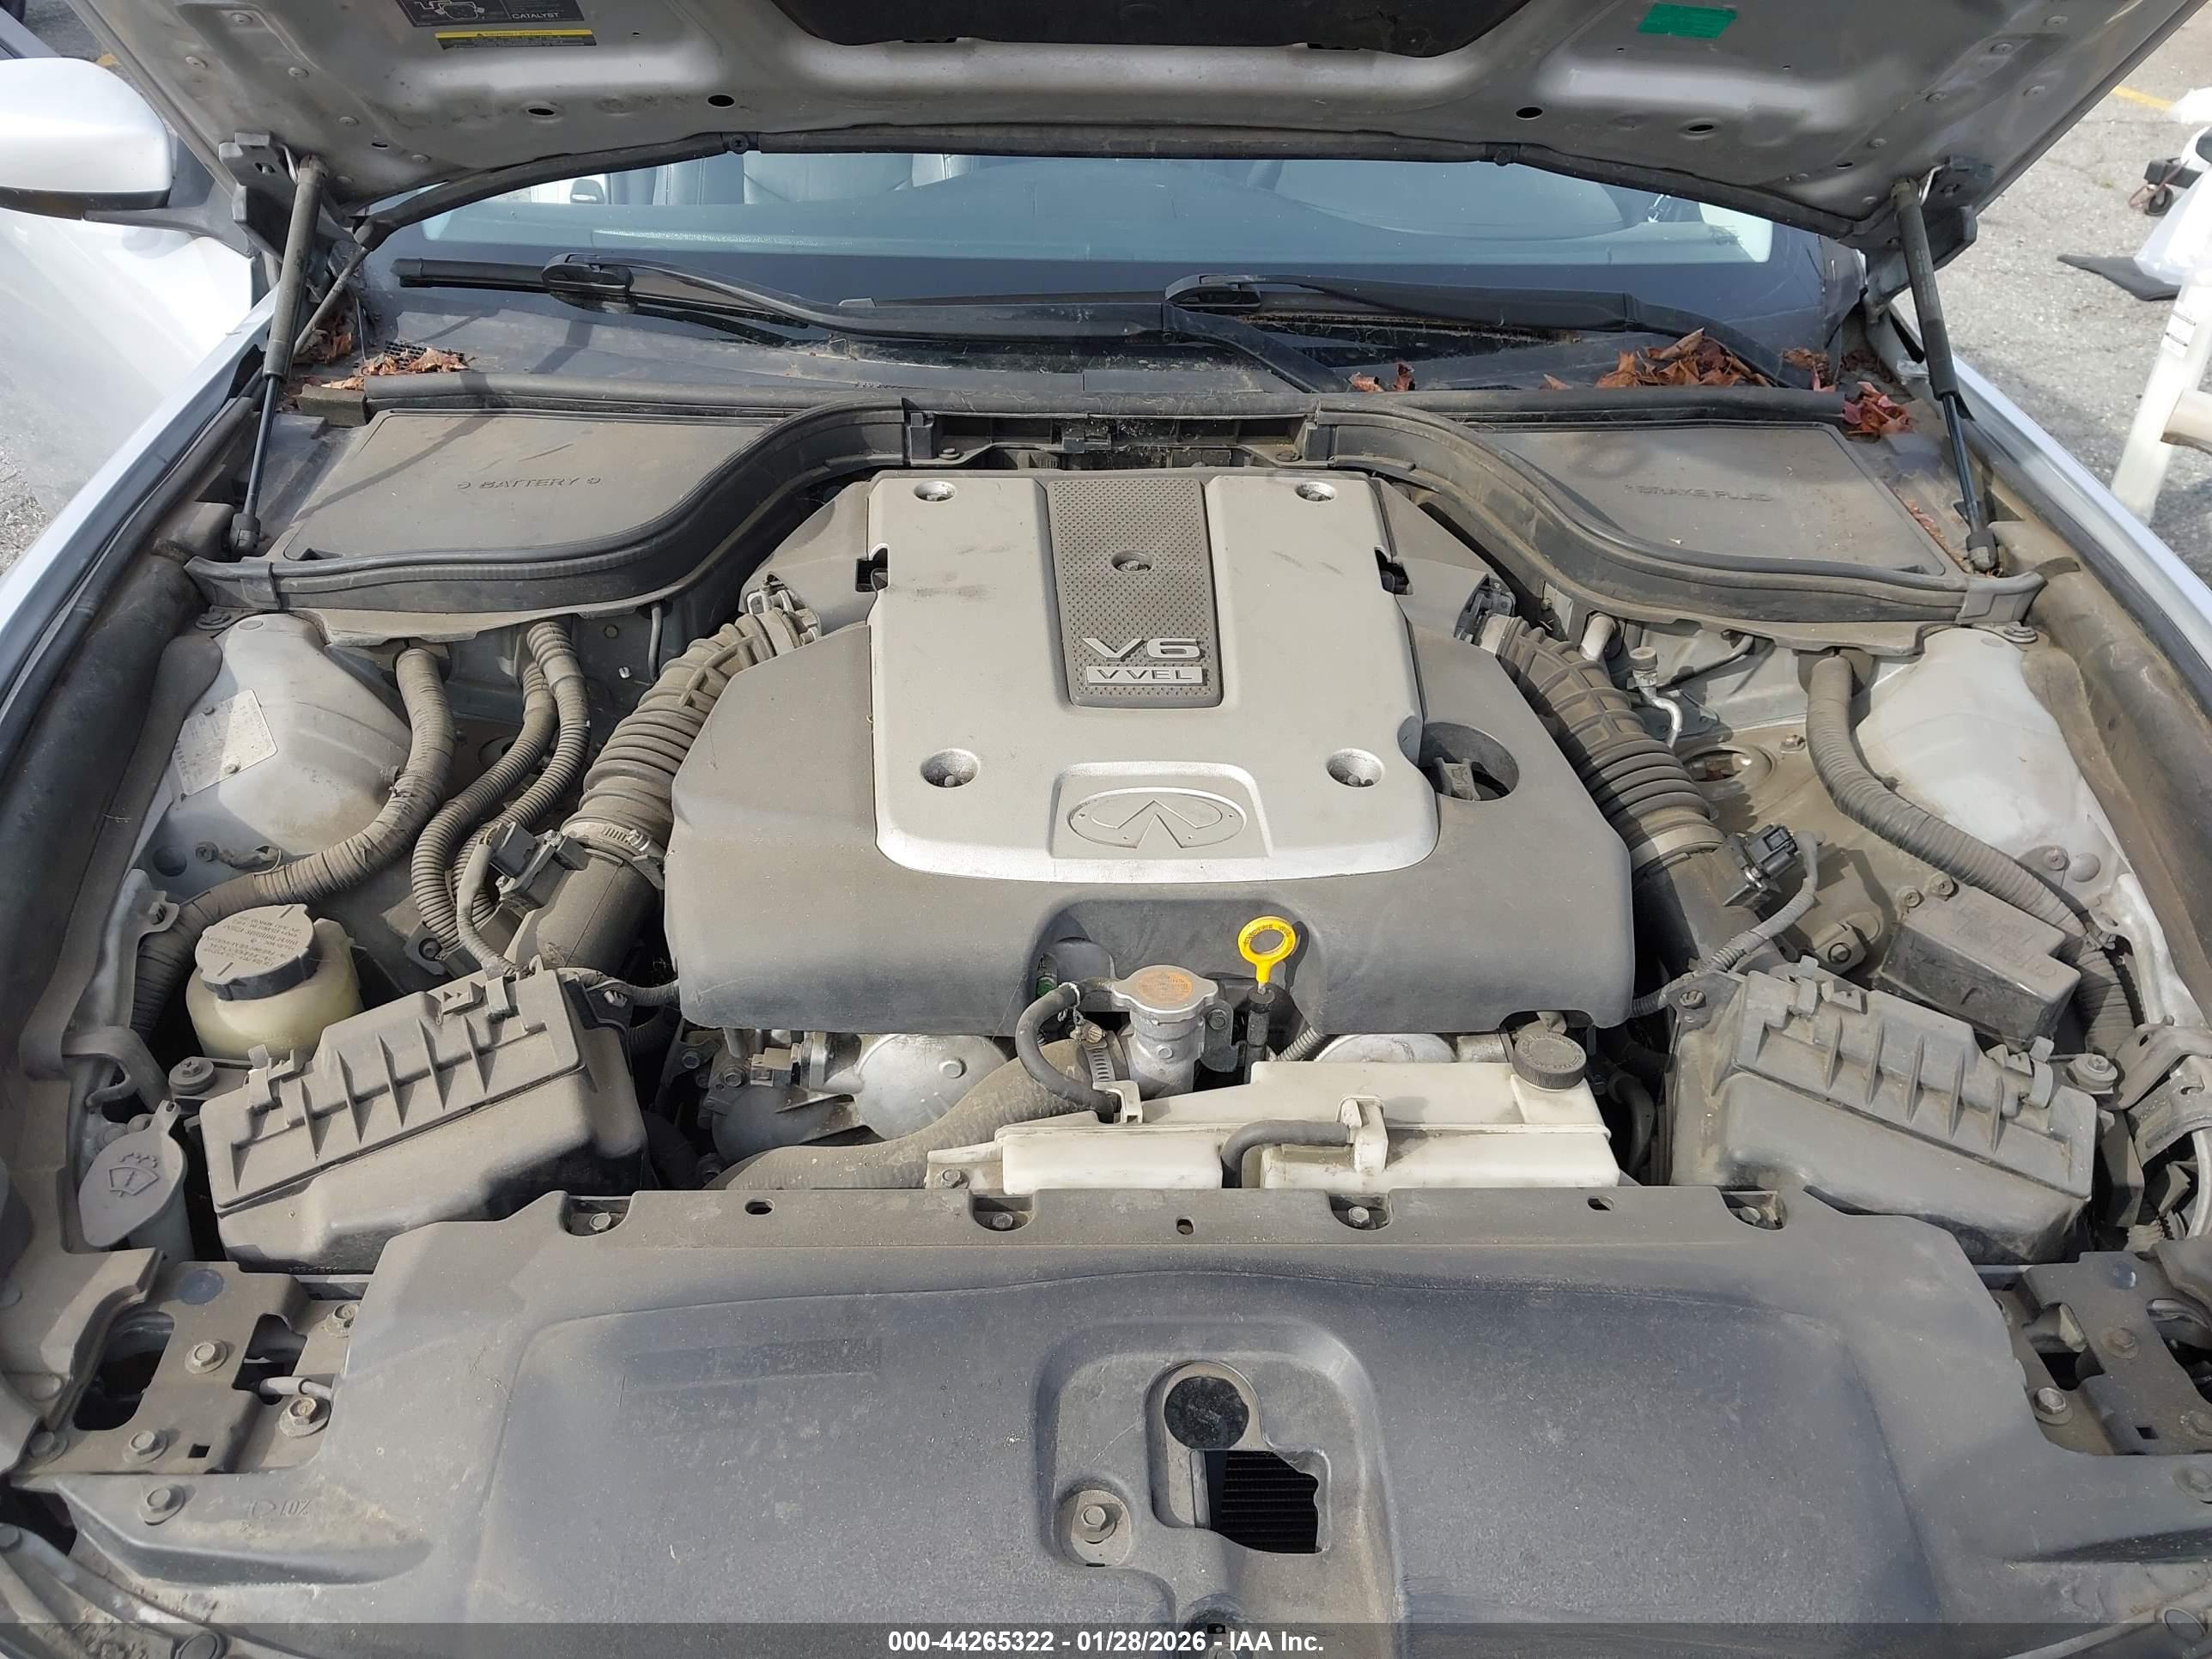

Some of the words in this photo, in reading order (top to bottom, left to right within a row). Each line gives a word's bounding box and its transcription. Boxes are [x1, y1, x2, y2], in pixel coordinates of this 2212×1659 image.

[479, 477, 580, 489] BATTERY
[1083, 638, 1202, 661] V6
[1097, 669, 1193, 680] VVEL
